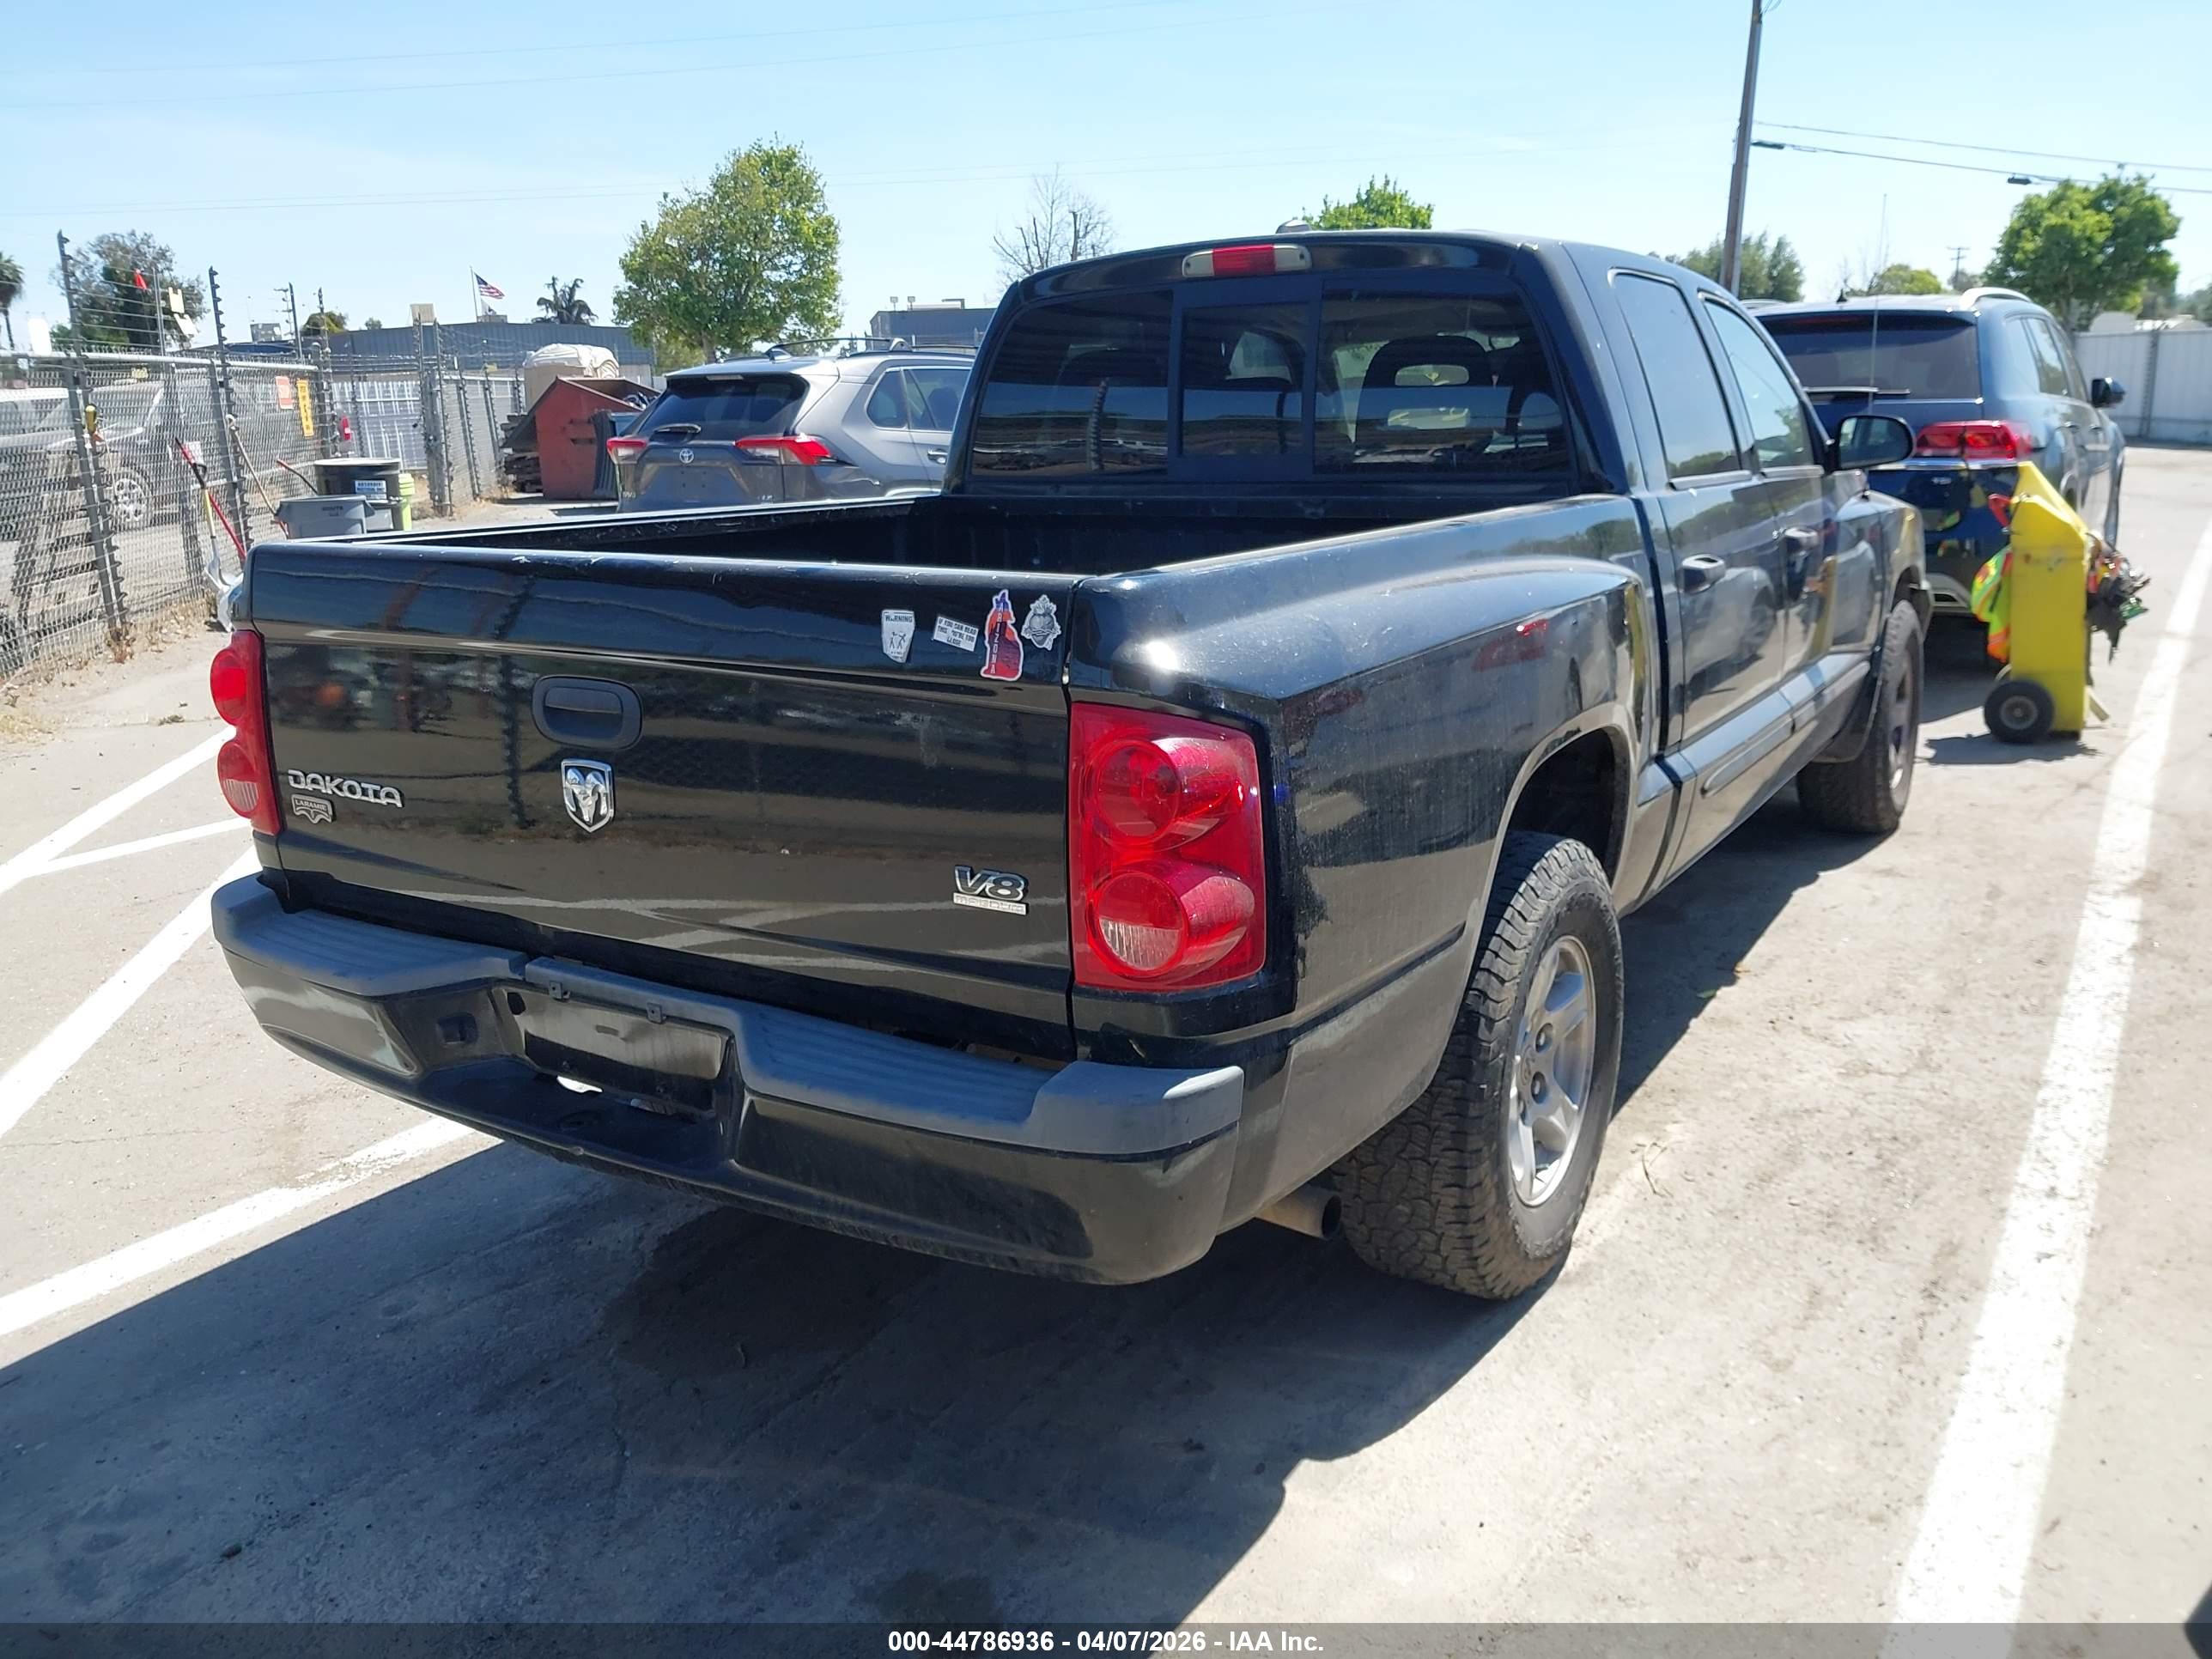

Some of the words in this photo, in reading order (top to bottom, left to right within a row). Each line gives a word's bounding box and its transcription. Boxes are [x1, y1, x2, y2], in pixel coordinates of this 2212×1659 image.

[288, 769, 404, 808] DAKOTA
[295, 799, 327, 811] LARAMIE
[954, 866, 1025, 902] V8
